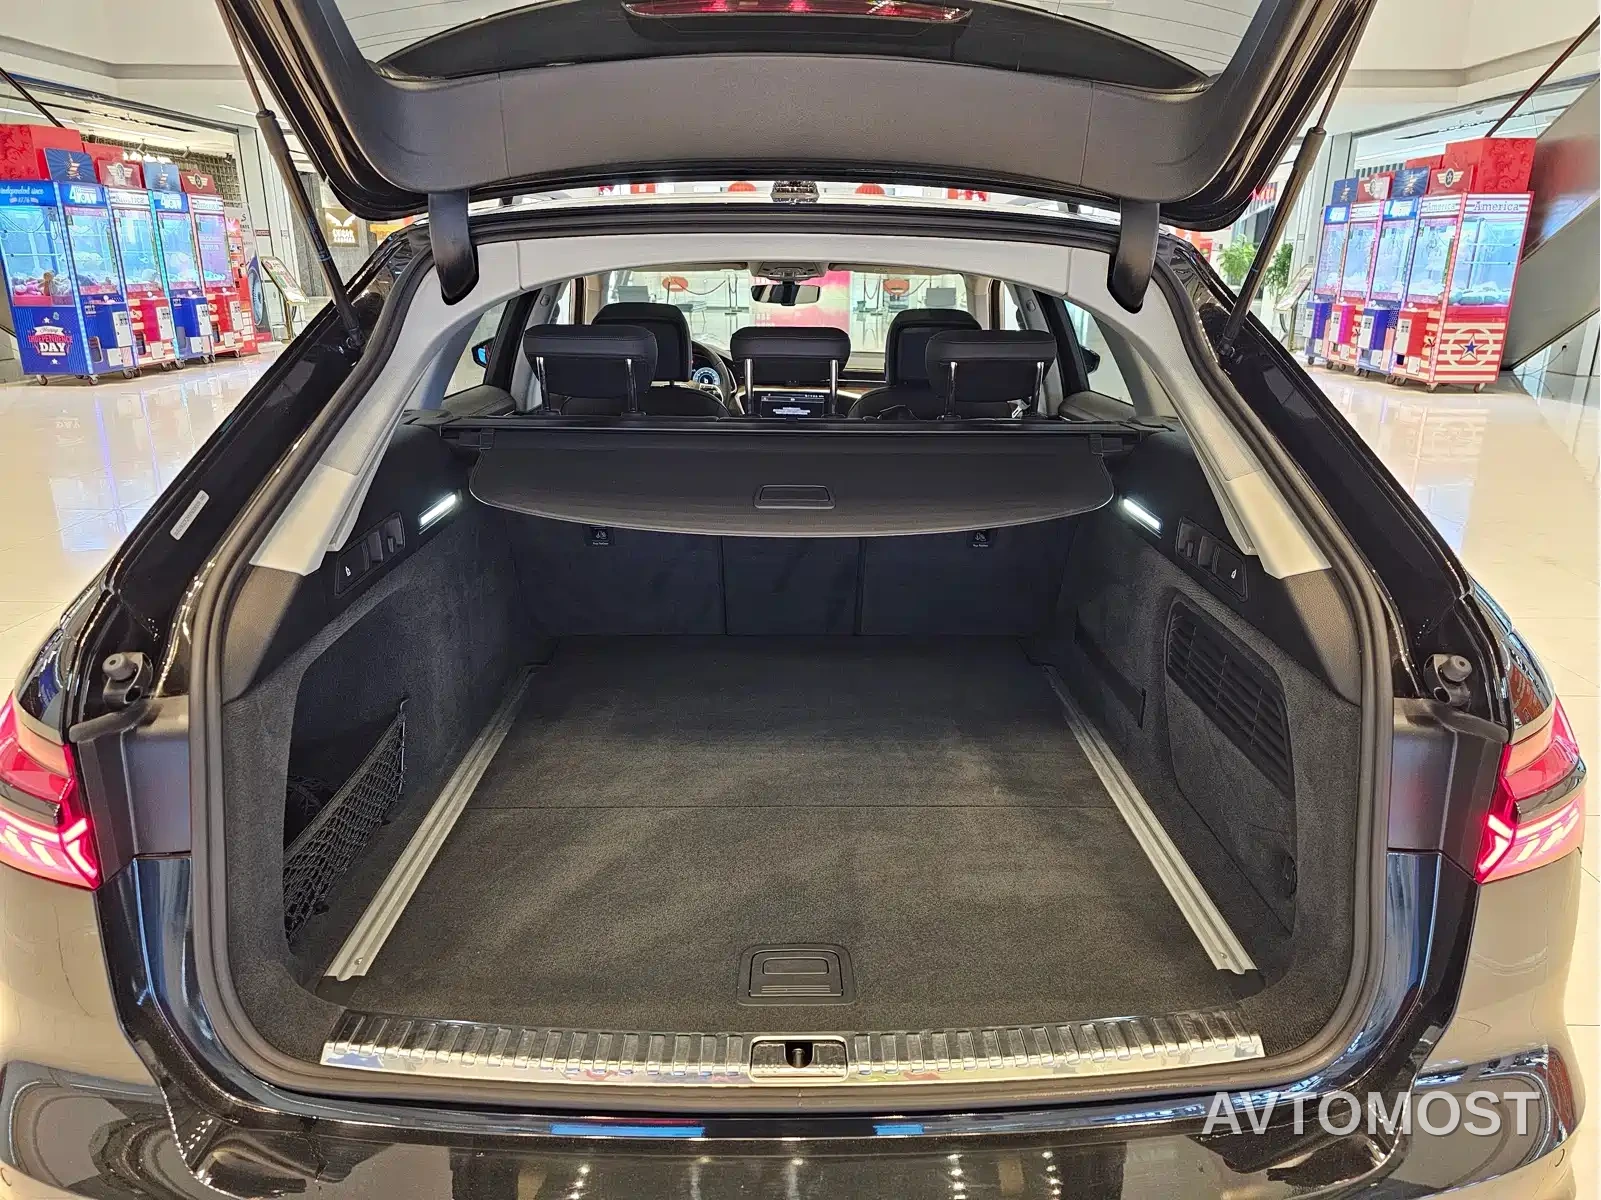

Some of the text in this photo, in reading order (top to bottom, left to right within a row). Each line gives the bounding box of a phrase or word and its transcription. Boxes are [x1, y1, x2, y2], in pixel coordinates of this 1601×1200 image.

[1473, 200, 1519, 212] America
[28, 333, 73, 344] INDEPENDENCE
[39, 342, 66, 352] DAY
